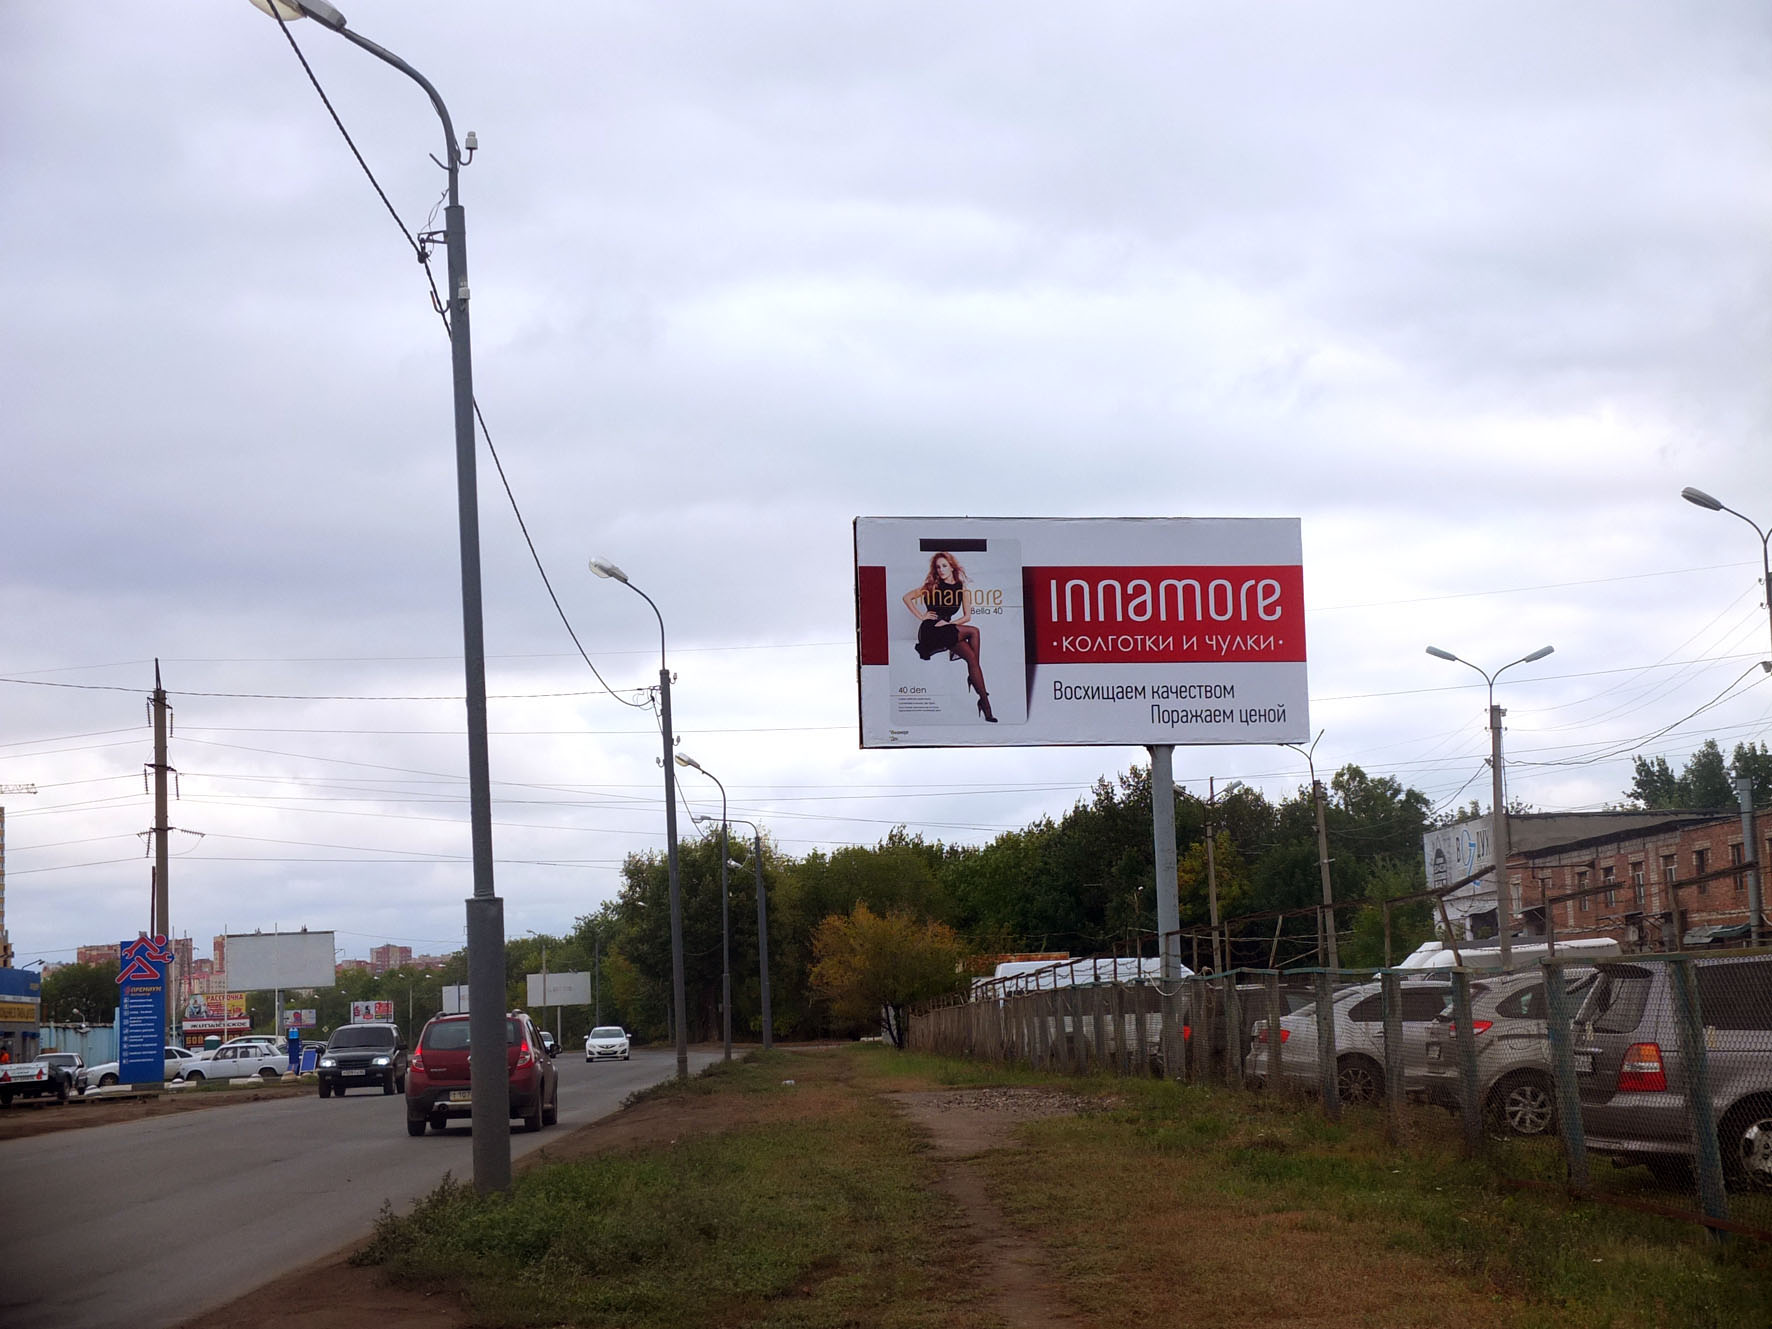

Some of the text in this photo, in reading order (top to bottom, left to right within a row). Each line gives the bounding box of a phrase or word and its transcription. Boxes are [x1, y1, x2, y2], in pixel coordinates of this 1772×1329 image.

[970, 606, 1003, 615] Bella 40
[898, 686, 927, 694] 40 den
[1053, 680, 1235, 703] Восхищаем качеством
[1151, 703, 1287, 728] Поражаем ценой
